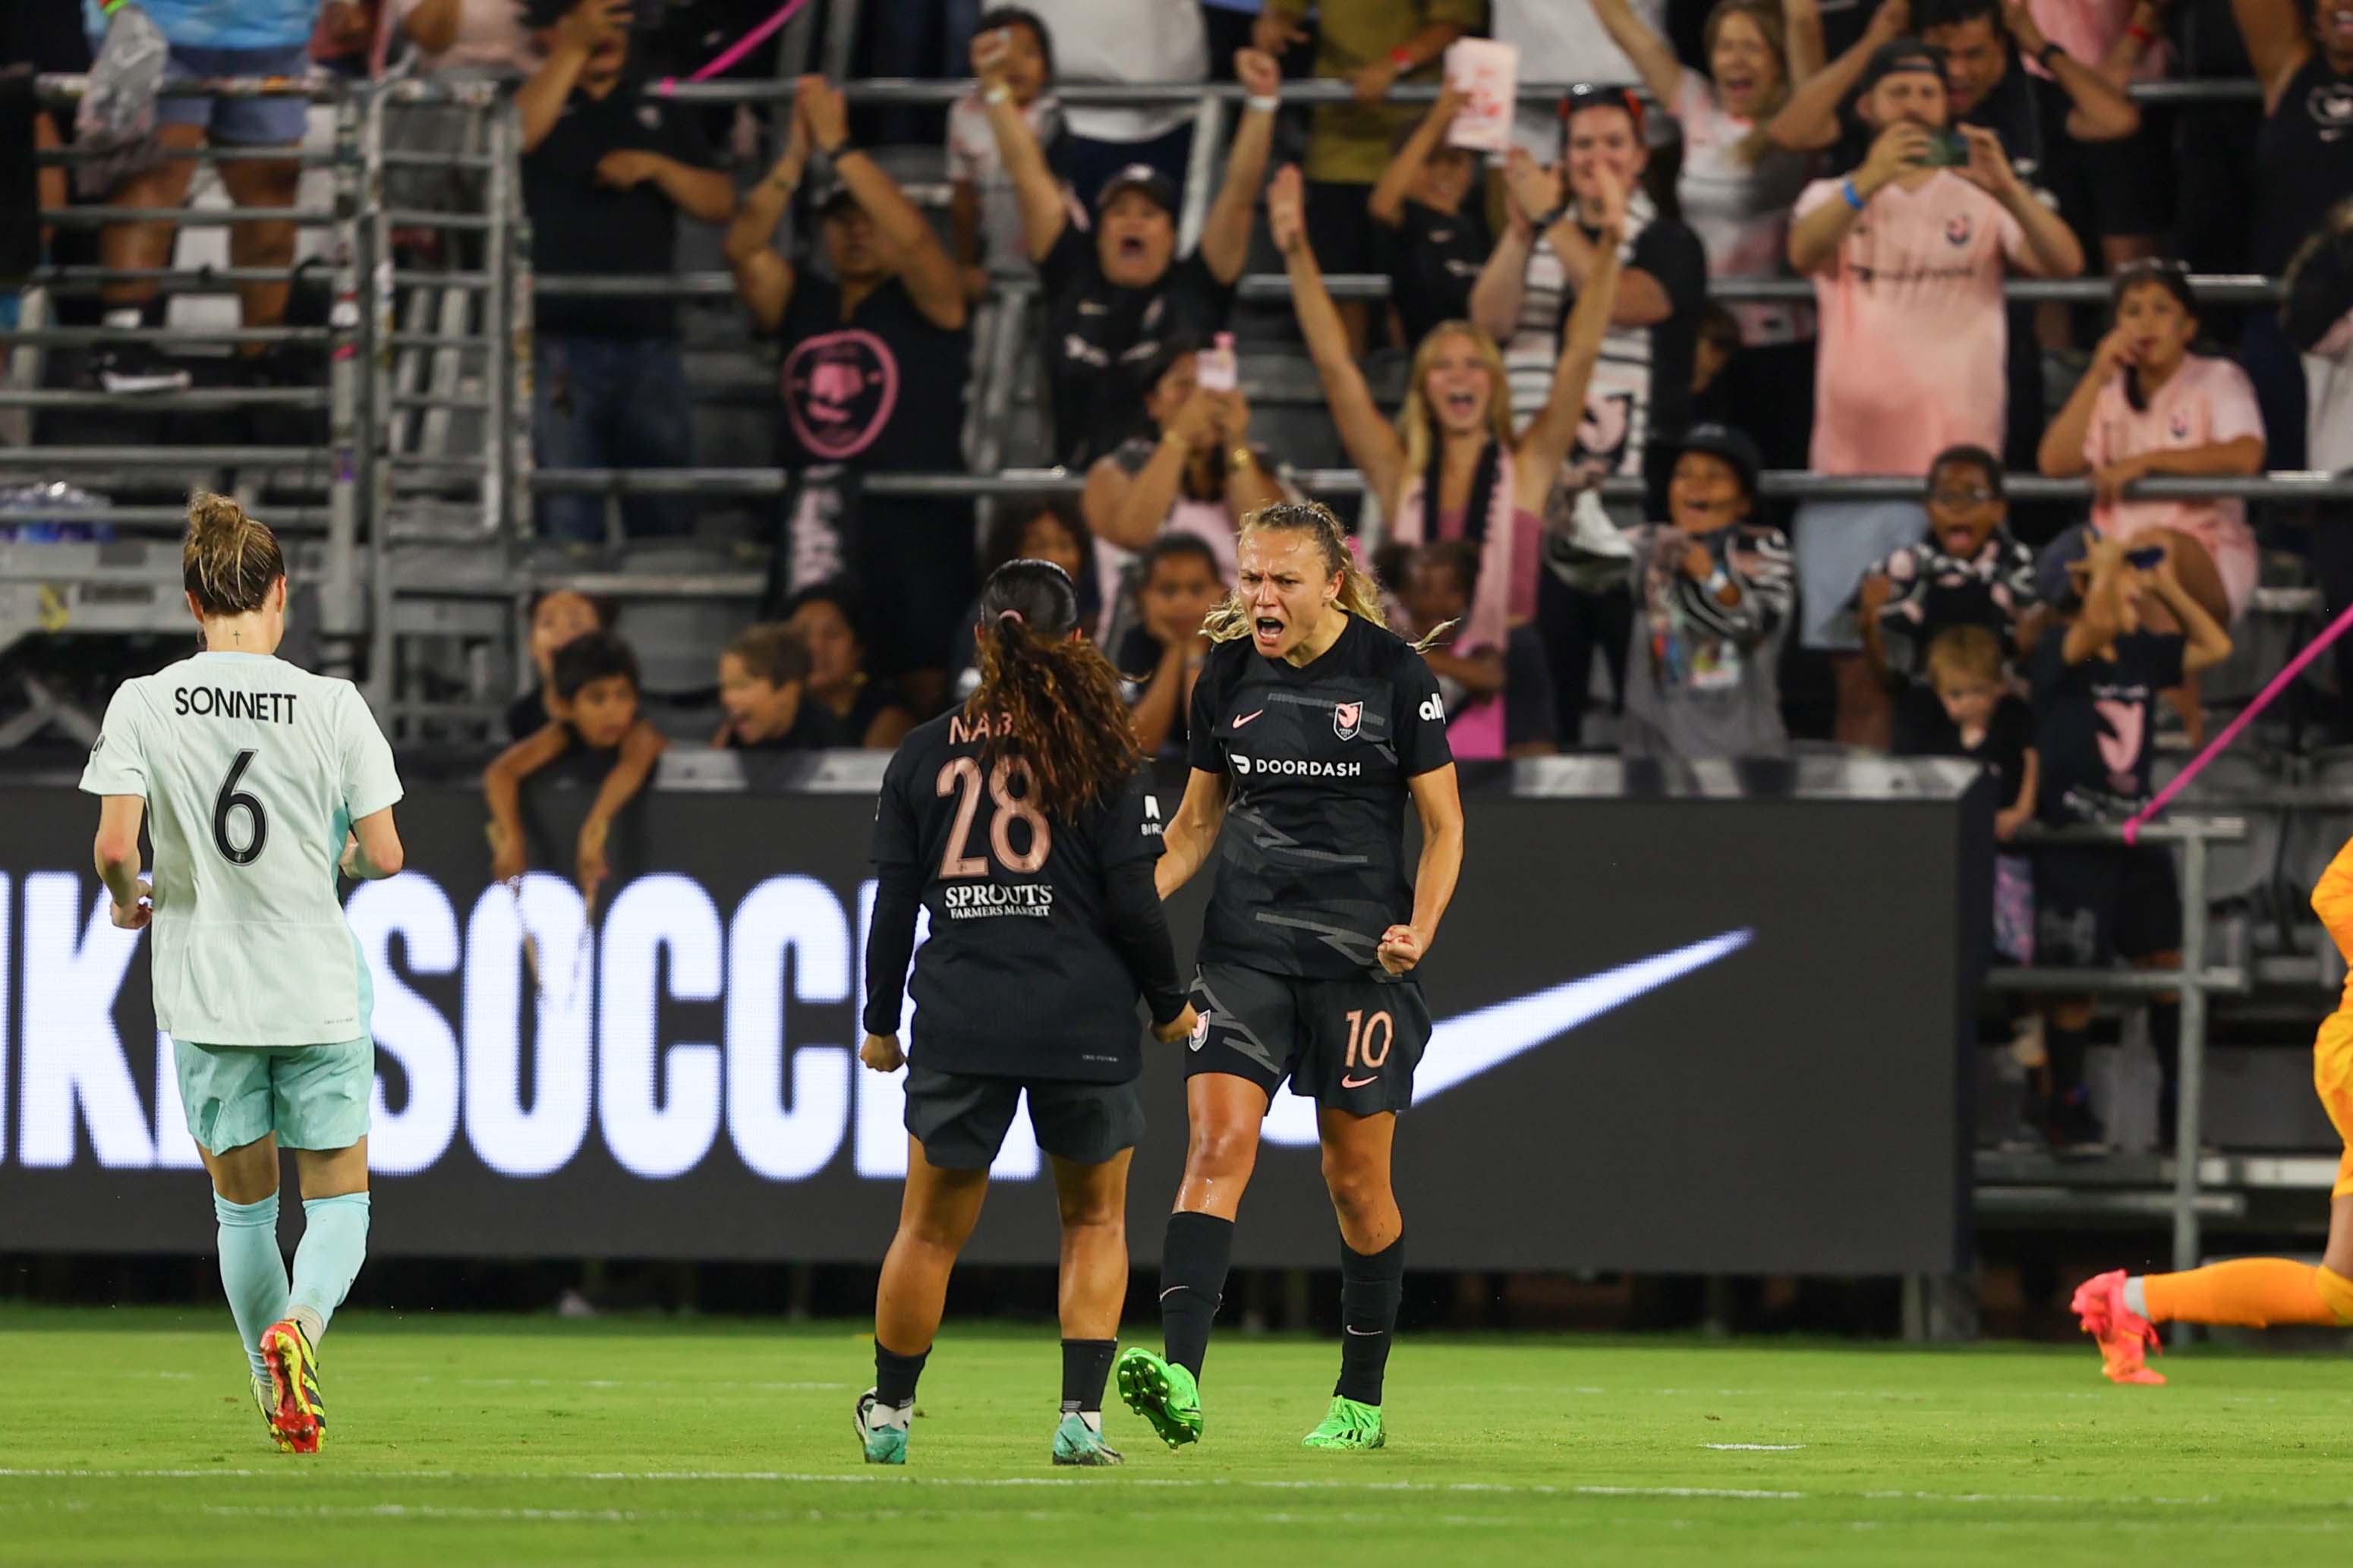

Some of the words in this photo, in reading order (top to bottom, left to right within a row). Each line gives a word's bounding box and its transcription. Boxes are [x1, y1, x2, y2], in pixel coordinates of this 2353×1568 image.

[175, 686, 297, 724] SONNETT
[1419, 692, 1446, 725] all
[949, 711, 1019, 745] NAB
[1255, 759, 1361, 776] DOORDASH
[212, 748, 269, 867] 6
[937, 754, 1052, 879] 28
[945, 883, 1053, 908] SPROUTS
[950, 905, 1003, 919] FARMERS
[1345, 1009, 1394, 1068] 10
